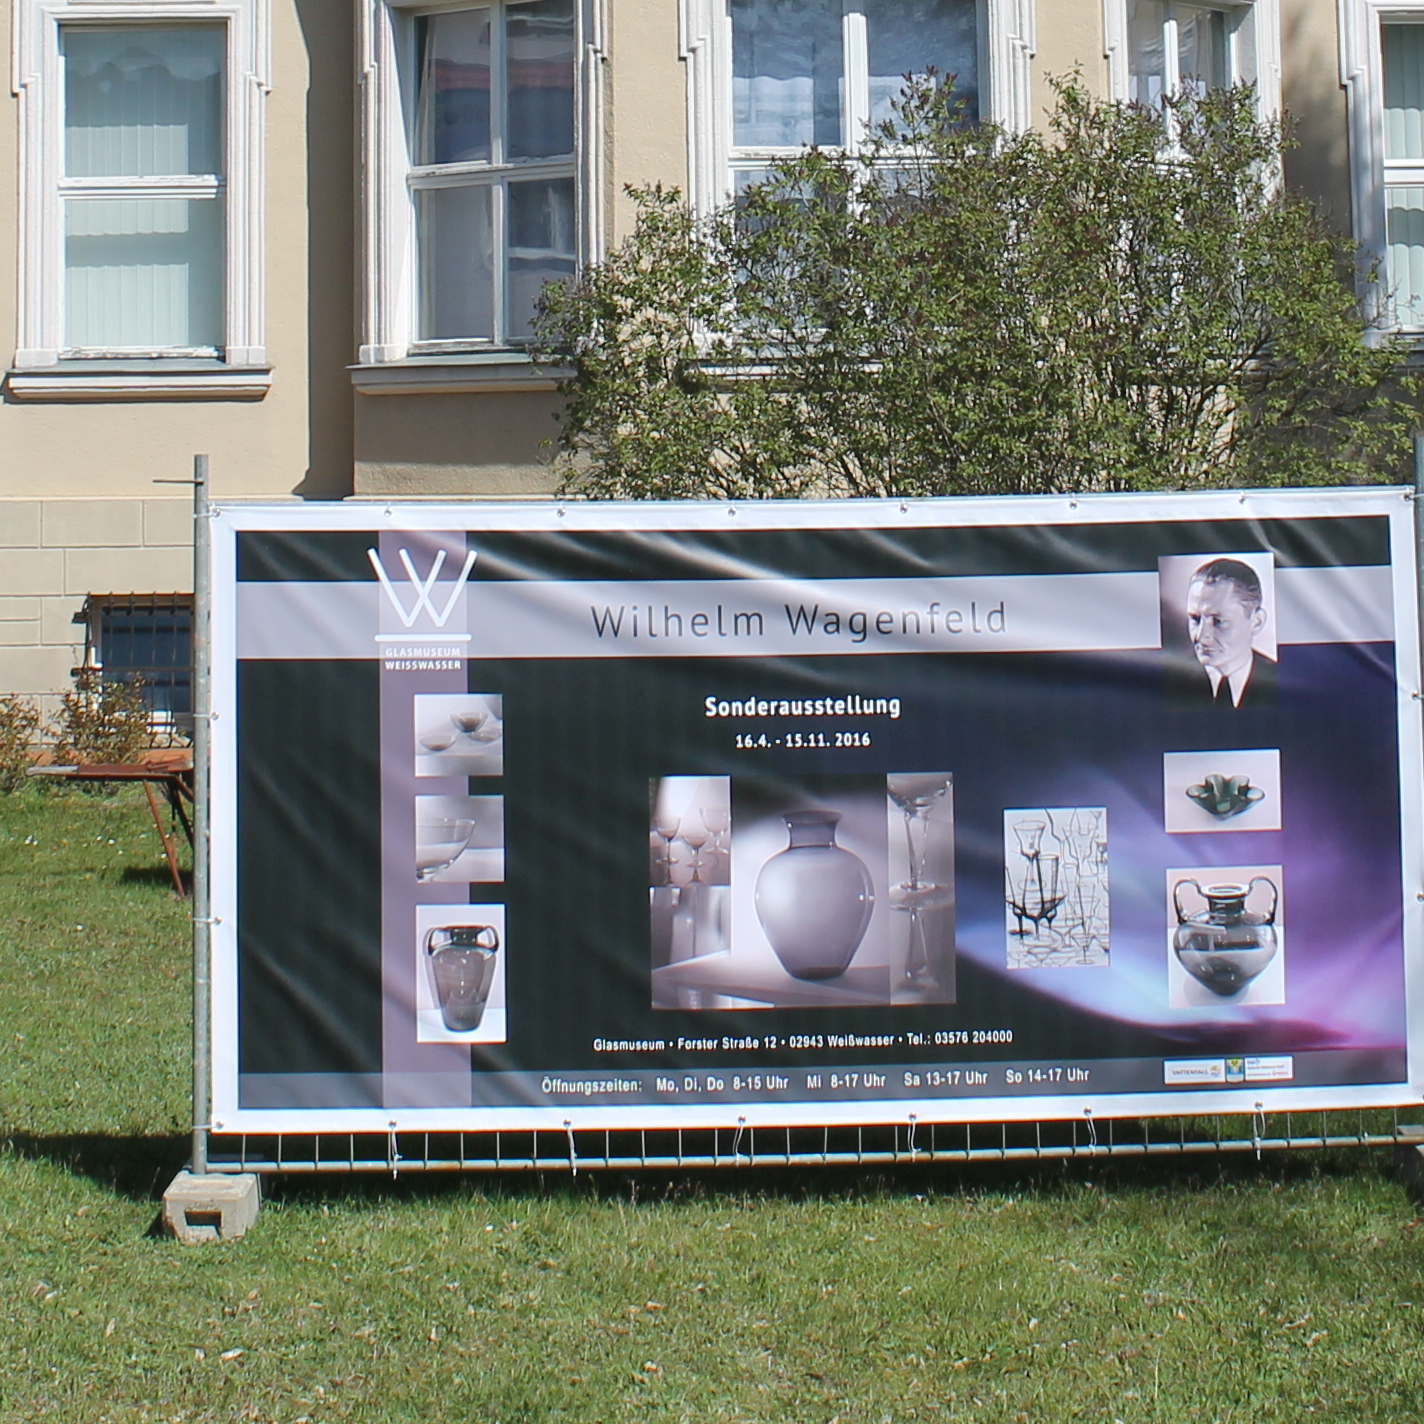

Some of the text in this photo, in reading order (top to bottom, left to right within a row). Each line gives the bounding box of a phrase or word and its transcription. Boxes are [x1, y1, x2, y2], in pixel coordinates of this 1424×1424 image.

[590, 600, 1007, 643] Wilhelm Wagenfeld
[385, 647, 461, 657] GLASMUSEUM
[385, 660, 461, 670] WEISSWASSER
[704, 694, 901, 719] Sonderausstellung
[735, 733, 772, 749] 16.4.
[785, 732, 832, 748] 15.11.
[835, 731, 871, 747] 2016
[593, 1038, 666, 1052] Glasmuseum
[677, 1037, 719, 1050] Forster
[722, 1036, 760, 1050] Straße
[763, 1036, 777, 1049] 12
[789, 1035, 824, 1048] 02943
[826, 1035, 895, 1048] Weißwasser
[934, 1031, 970, 1045] 03576
[972, 1030, 1014, 1044] 204000
[541, 1067, 1090, 1097] Öffnungszeiten: Mo, Di, Do 8-15 Uhr Mi 8-17 Uhr Sa 13-17 Uhr So 14-17 Uhr
